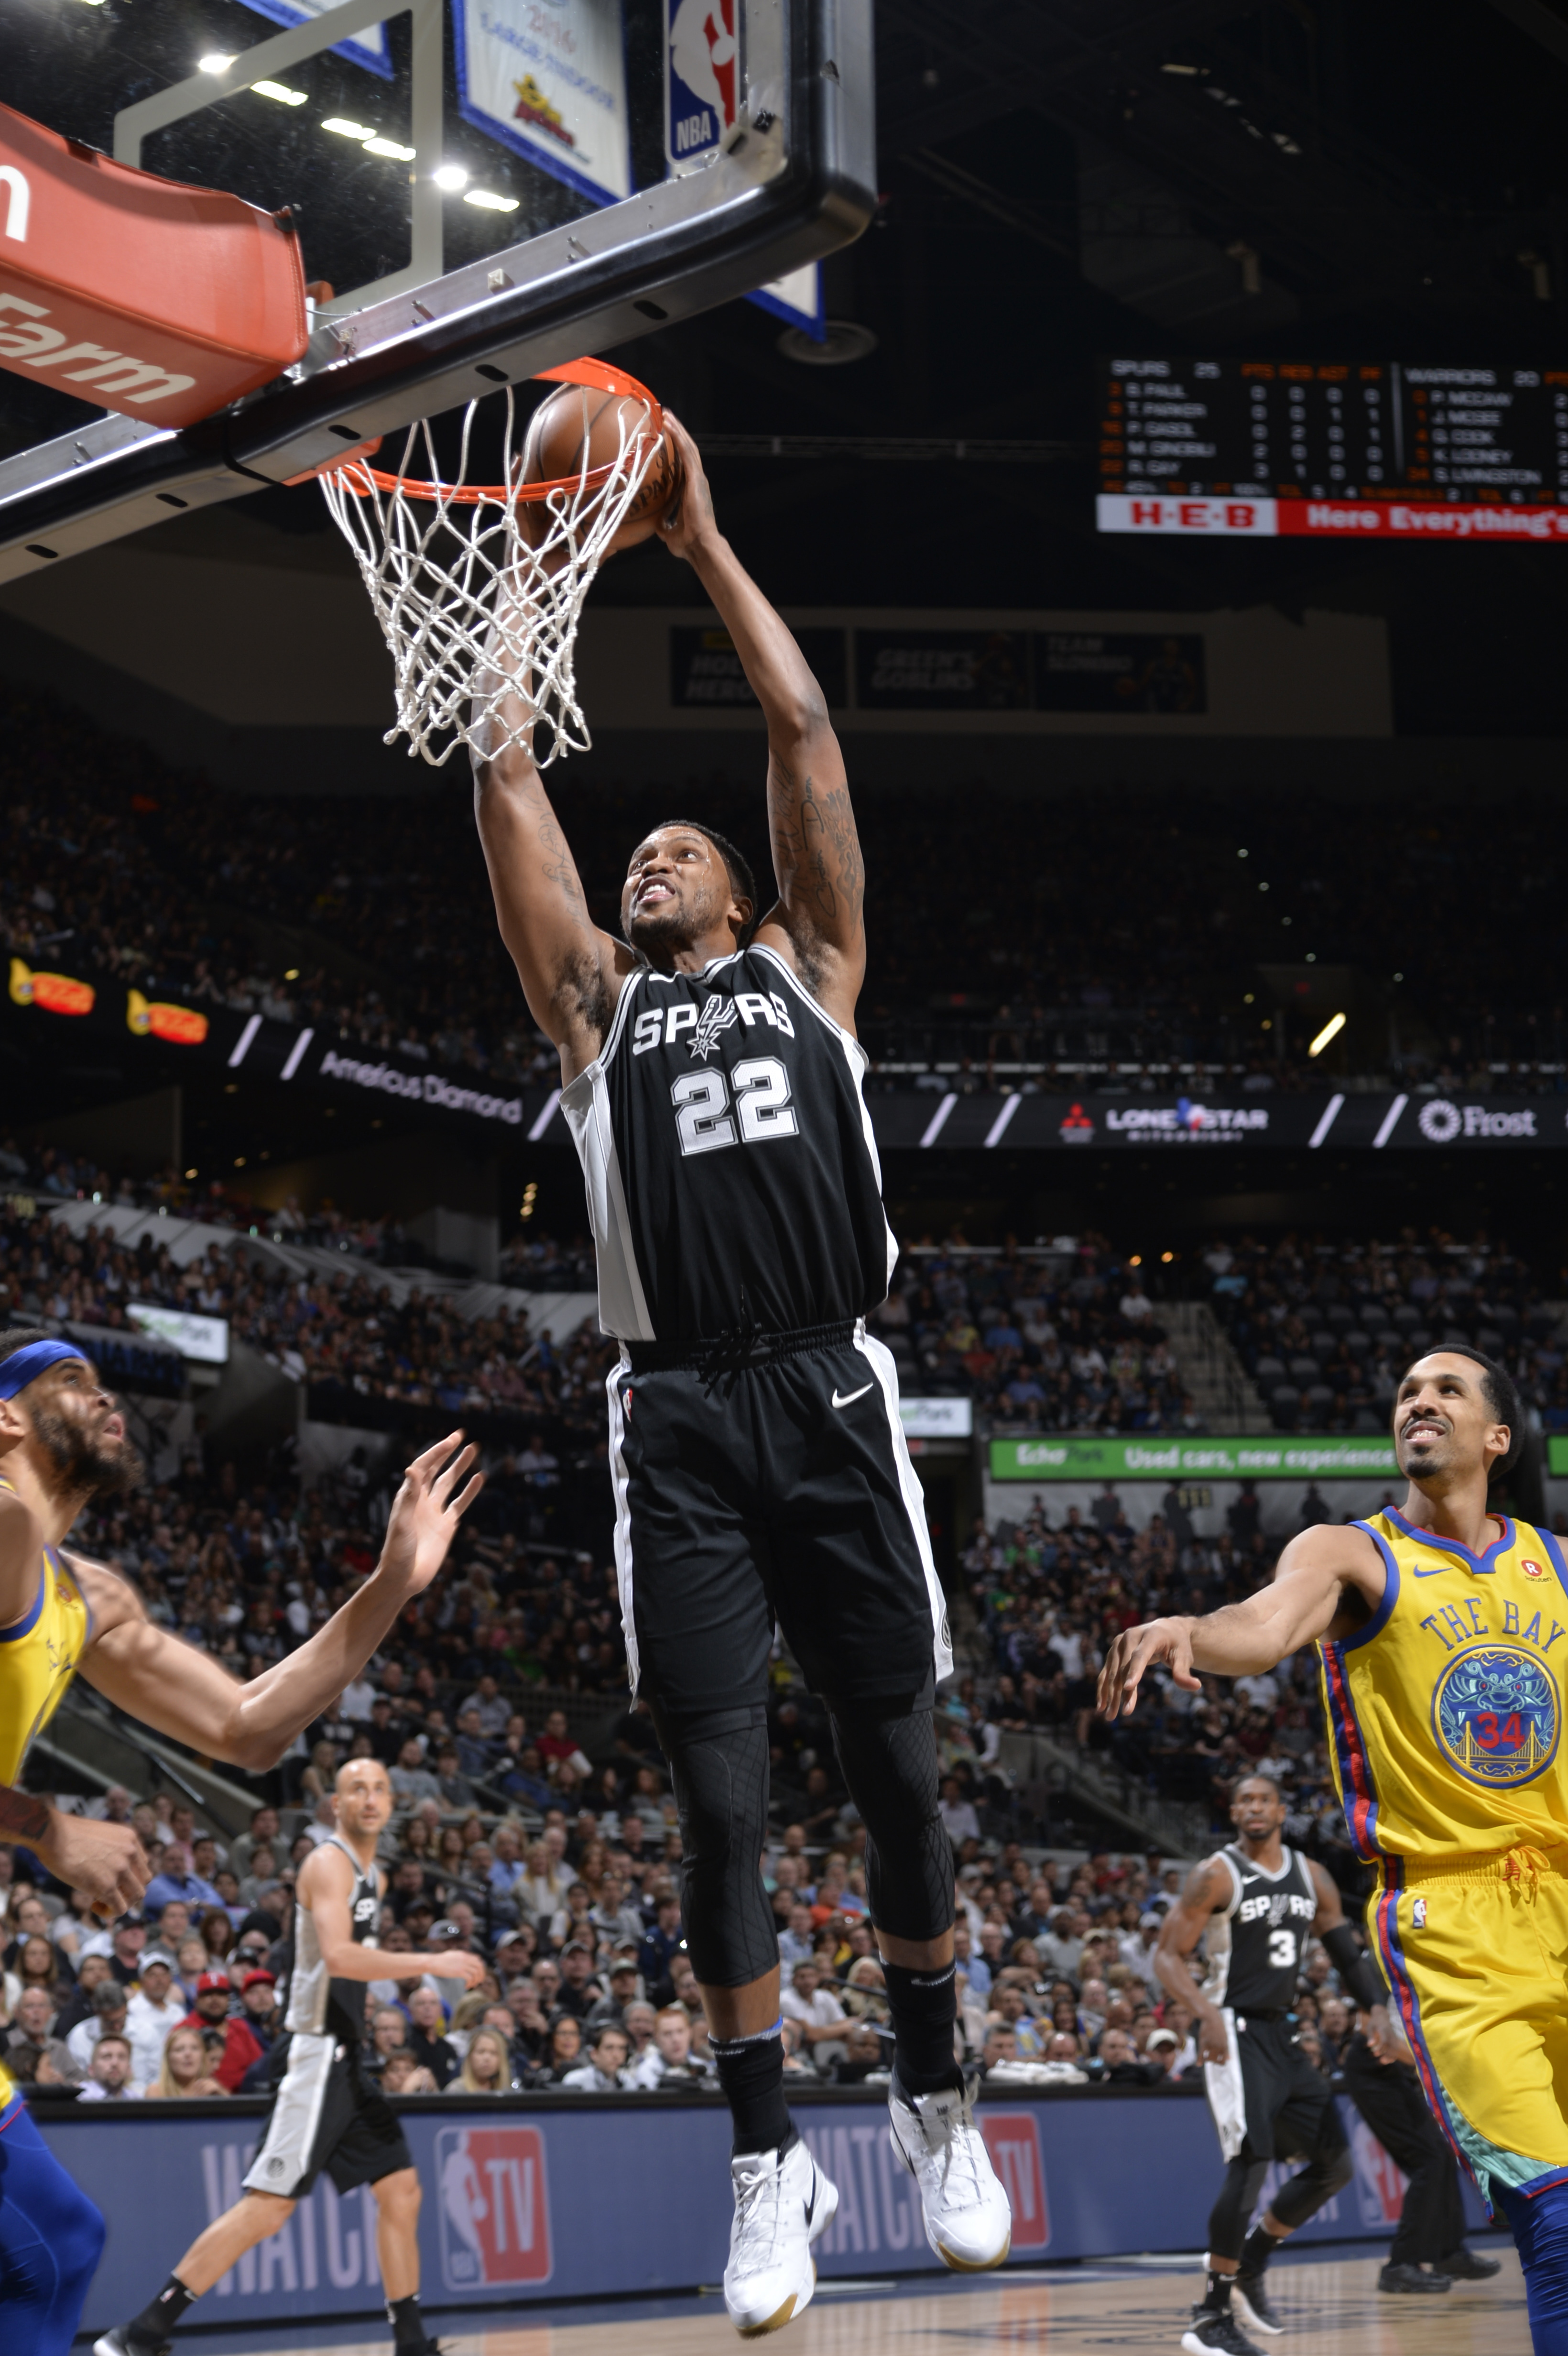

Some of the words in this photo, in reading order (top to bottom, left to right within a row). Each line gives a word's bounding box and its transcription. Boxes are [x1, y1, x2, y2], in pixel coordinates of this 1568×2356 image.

[677, 110, 711, 153] NBA
[1307, 504, 1381, 529] Here
[632, 991, 795, 1061] SPURS
[423, 1075, 523, 1124] Diamond
[670, 1055, 800, 1156] 22
[1106, 1109, 1179, 1130] LONE
[1198, 1109, 1269, 1129] STAR
[1462, 1105, 1538, 1136] Frost
[1124, 1445, 1179, 1469] Used
[1183, 1449, 1234, 1471] cars,
[1237, 1449, 1282, 1469] new
[1420, 1597, 1489, 1651] THE
[1502, 1599, 1566, 1653] BAY
[1476, 1711, 1525, 1749] 34
[1240, 1893, 1316, 1927] SPURS
[1268, 1929, 1296, 1967] 3
[485, 2157, 535, 2253] TV
